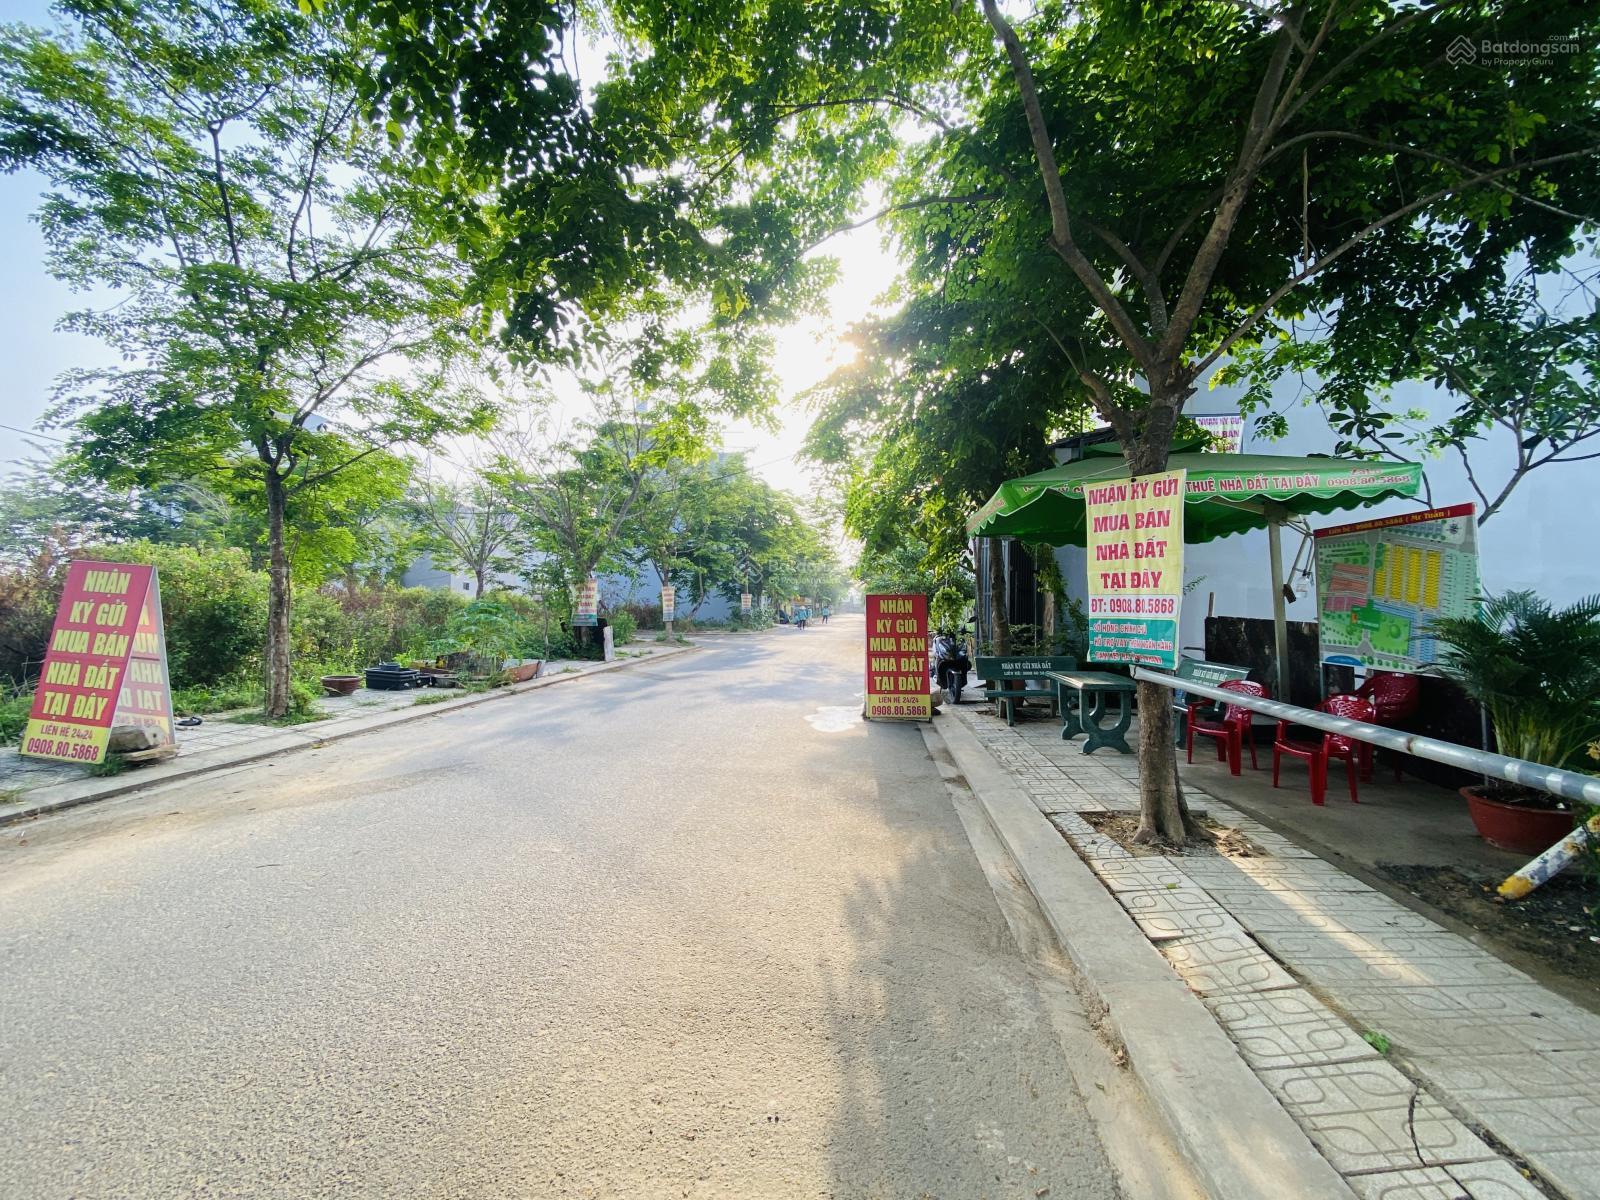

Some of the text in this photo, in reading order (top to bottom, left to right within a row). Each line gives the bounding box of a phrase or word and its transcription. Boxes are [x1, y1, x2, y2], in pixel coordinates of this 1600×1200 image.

[1088, 474, 1179, 507] NHẬN KÝ GỬI
[1185, 473, 1216, 493] THUÊ
[1219, 472, 1242, 492] NHÀ
[1247, 470, 1270, 491] ĐẤT
[1272, 473, 1294, 492] TẠI
[1295, 472, 1320, 489] ĐÂY
[1327, 474, 1412, 488] 0908.80.5868
[1093, 507, 1171, 533] MUA BÁN
[1096, 535, 1168, 562] NHÀ ĐẤT
[83, 568, 131, 597] NHẬN
[1101, 568, 1163, 592] TẠI ĐÂY
[69, 599, 95, 624] KÝ
[96, 598, 128, 627] GỬI
[879, 598, 913, 616] NHẬN
[1090, 597, 1175, 614] ĐT: 0908.80.5868
[896, 616, 918, 633] GỬI
[52, 629, 130, 658] MUA BÁN
[870, 635, 926, 652] MUA BÁN
[871, 653, 925, 672] NHÀ ĐẤT
[45, 659, 120, 690] NHÀ ĐẤT
[874, 674, 923, 693] TẠI ĐÂY
[42, 691, 109, 721] TẠI ĐÂY
[871, 705, 927, 716] 0908.80.5868
[878, 695, 892, 704] LIÊN
[41, 722, 59, 736] LIÊN
[27, 737, 99, 761] 0908.80.5868
